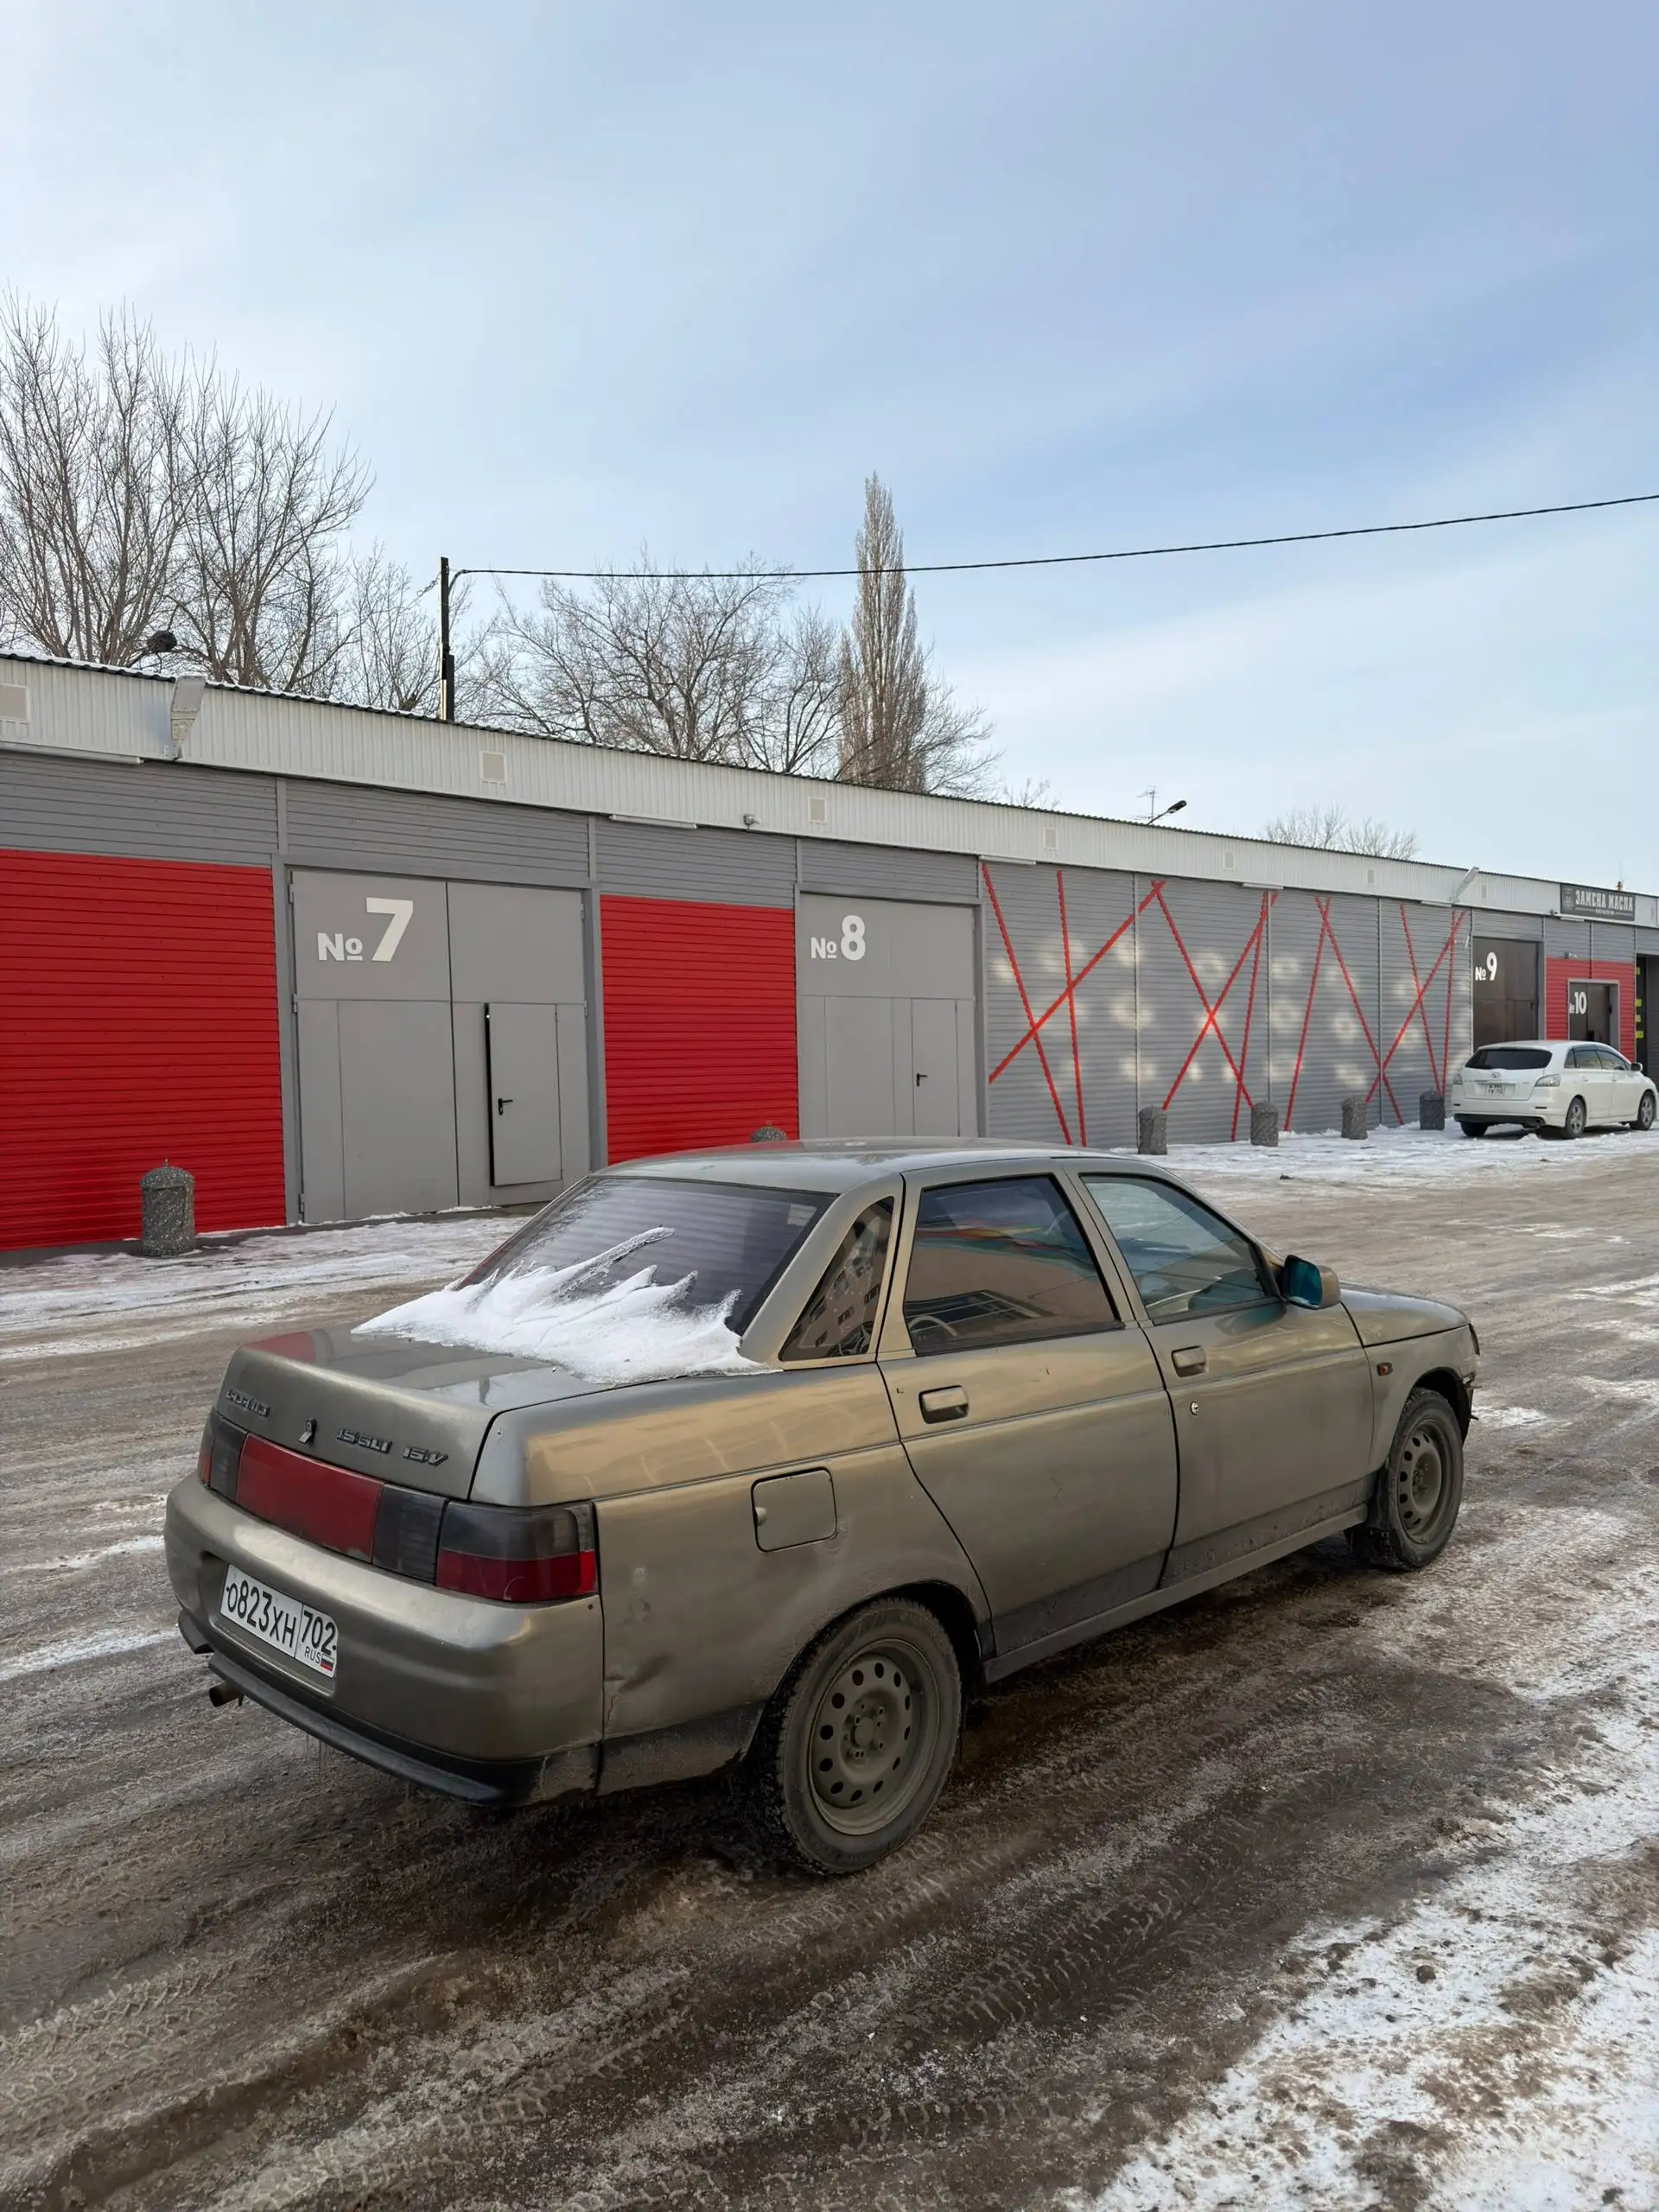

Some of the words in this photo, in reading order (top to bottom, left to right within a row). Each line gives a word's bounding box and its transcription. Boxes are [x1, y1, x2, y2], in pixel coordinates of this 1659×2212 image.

[1575, 890, 1606, 908] ЗАМЕНА
[1608, 894, 1633, 912] МАСЛА
[304, 1646, 321, 1665] RUS
